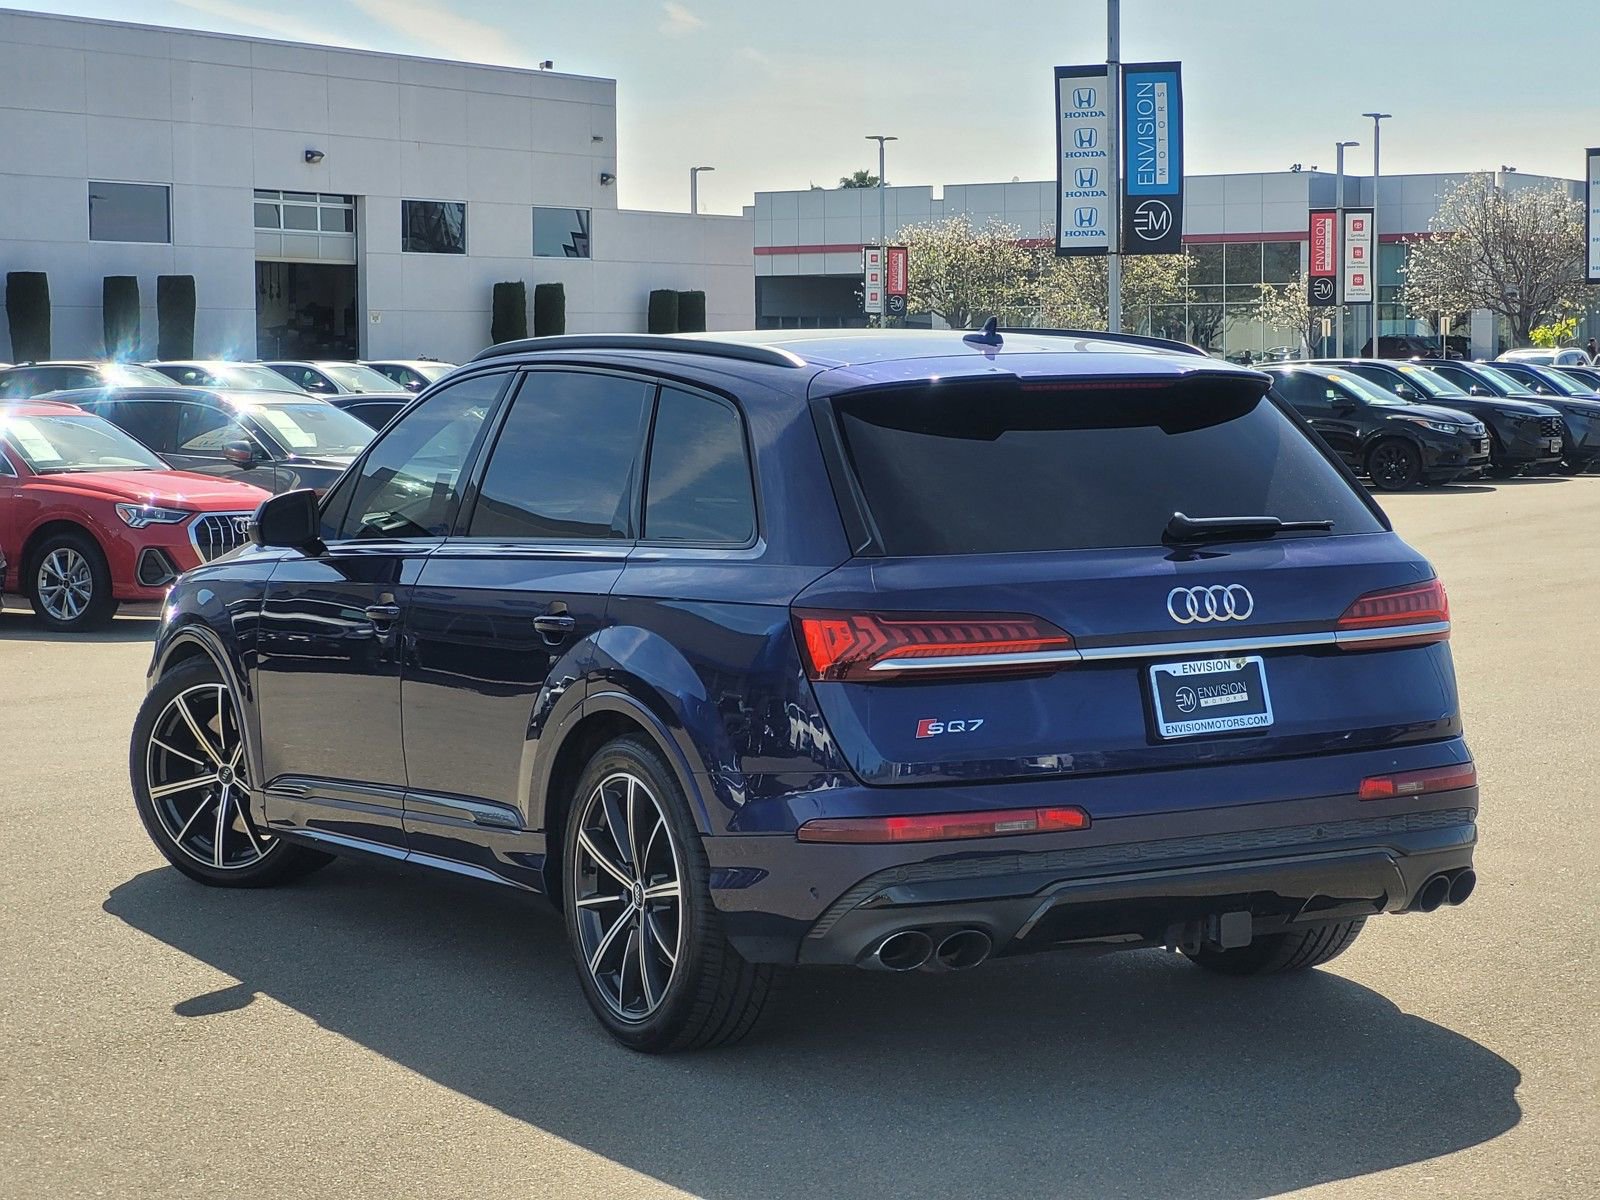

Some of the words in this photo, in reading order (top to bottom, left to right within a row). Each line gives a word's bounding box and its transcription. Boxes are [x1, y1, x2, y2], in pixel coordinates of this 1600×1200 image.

[1064, 110, 1106, 119] HONDA
[1136, 82, 1155, 185] ENVISION
[1158, 91, 1166, 176] MOTORS
[1065, 150, 1107, 158] HONDA
[1065, 190, 1107, 198] HONDA
[1064, 229, 1106, 237] HONDA
[1315, 218, 1325, 271] ENVISION
[891, 252, 899, 291] ENVISION
[1182, 660, 1231, 674] ENVISION
[1197, 681, 1247, 698] ENVISION
[1204, 695, 1244, 705] MOTORS
[927, 719, 984, 735] SQ7
[1165, 716, 1269, 734] ENVISIONMOTORS.COM
